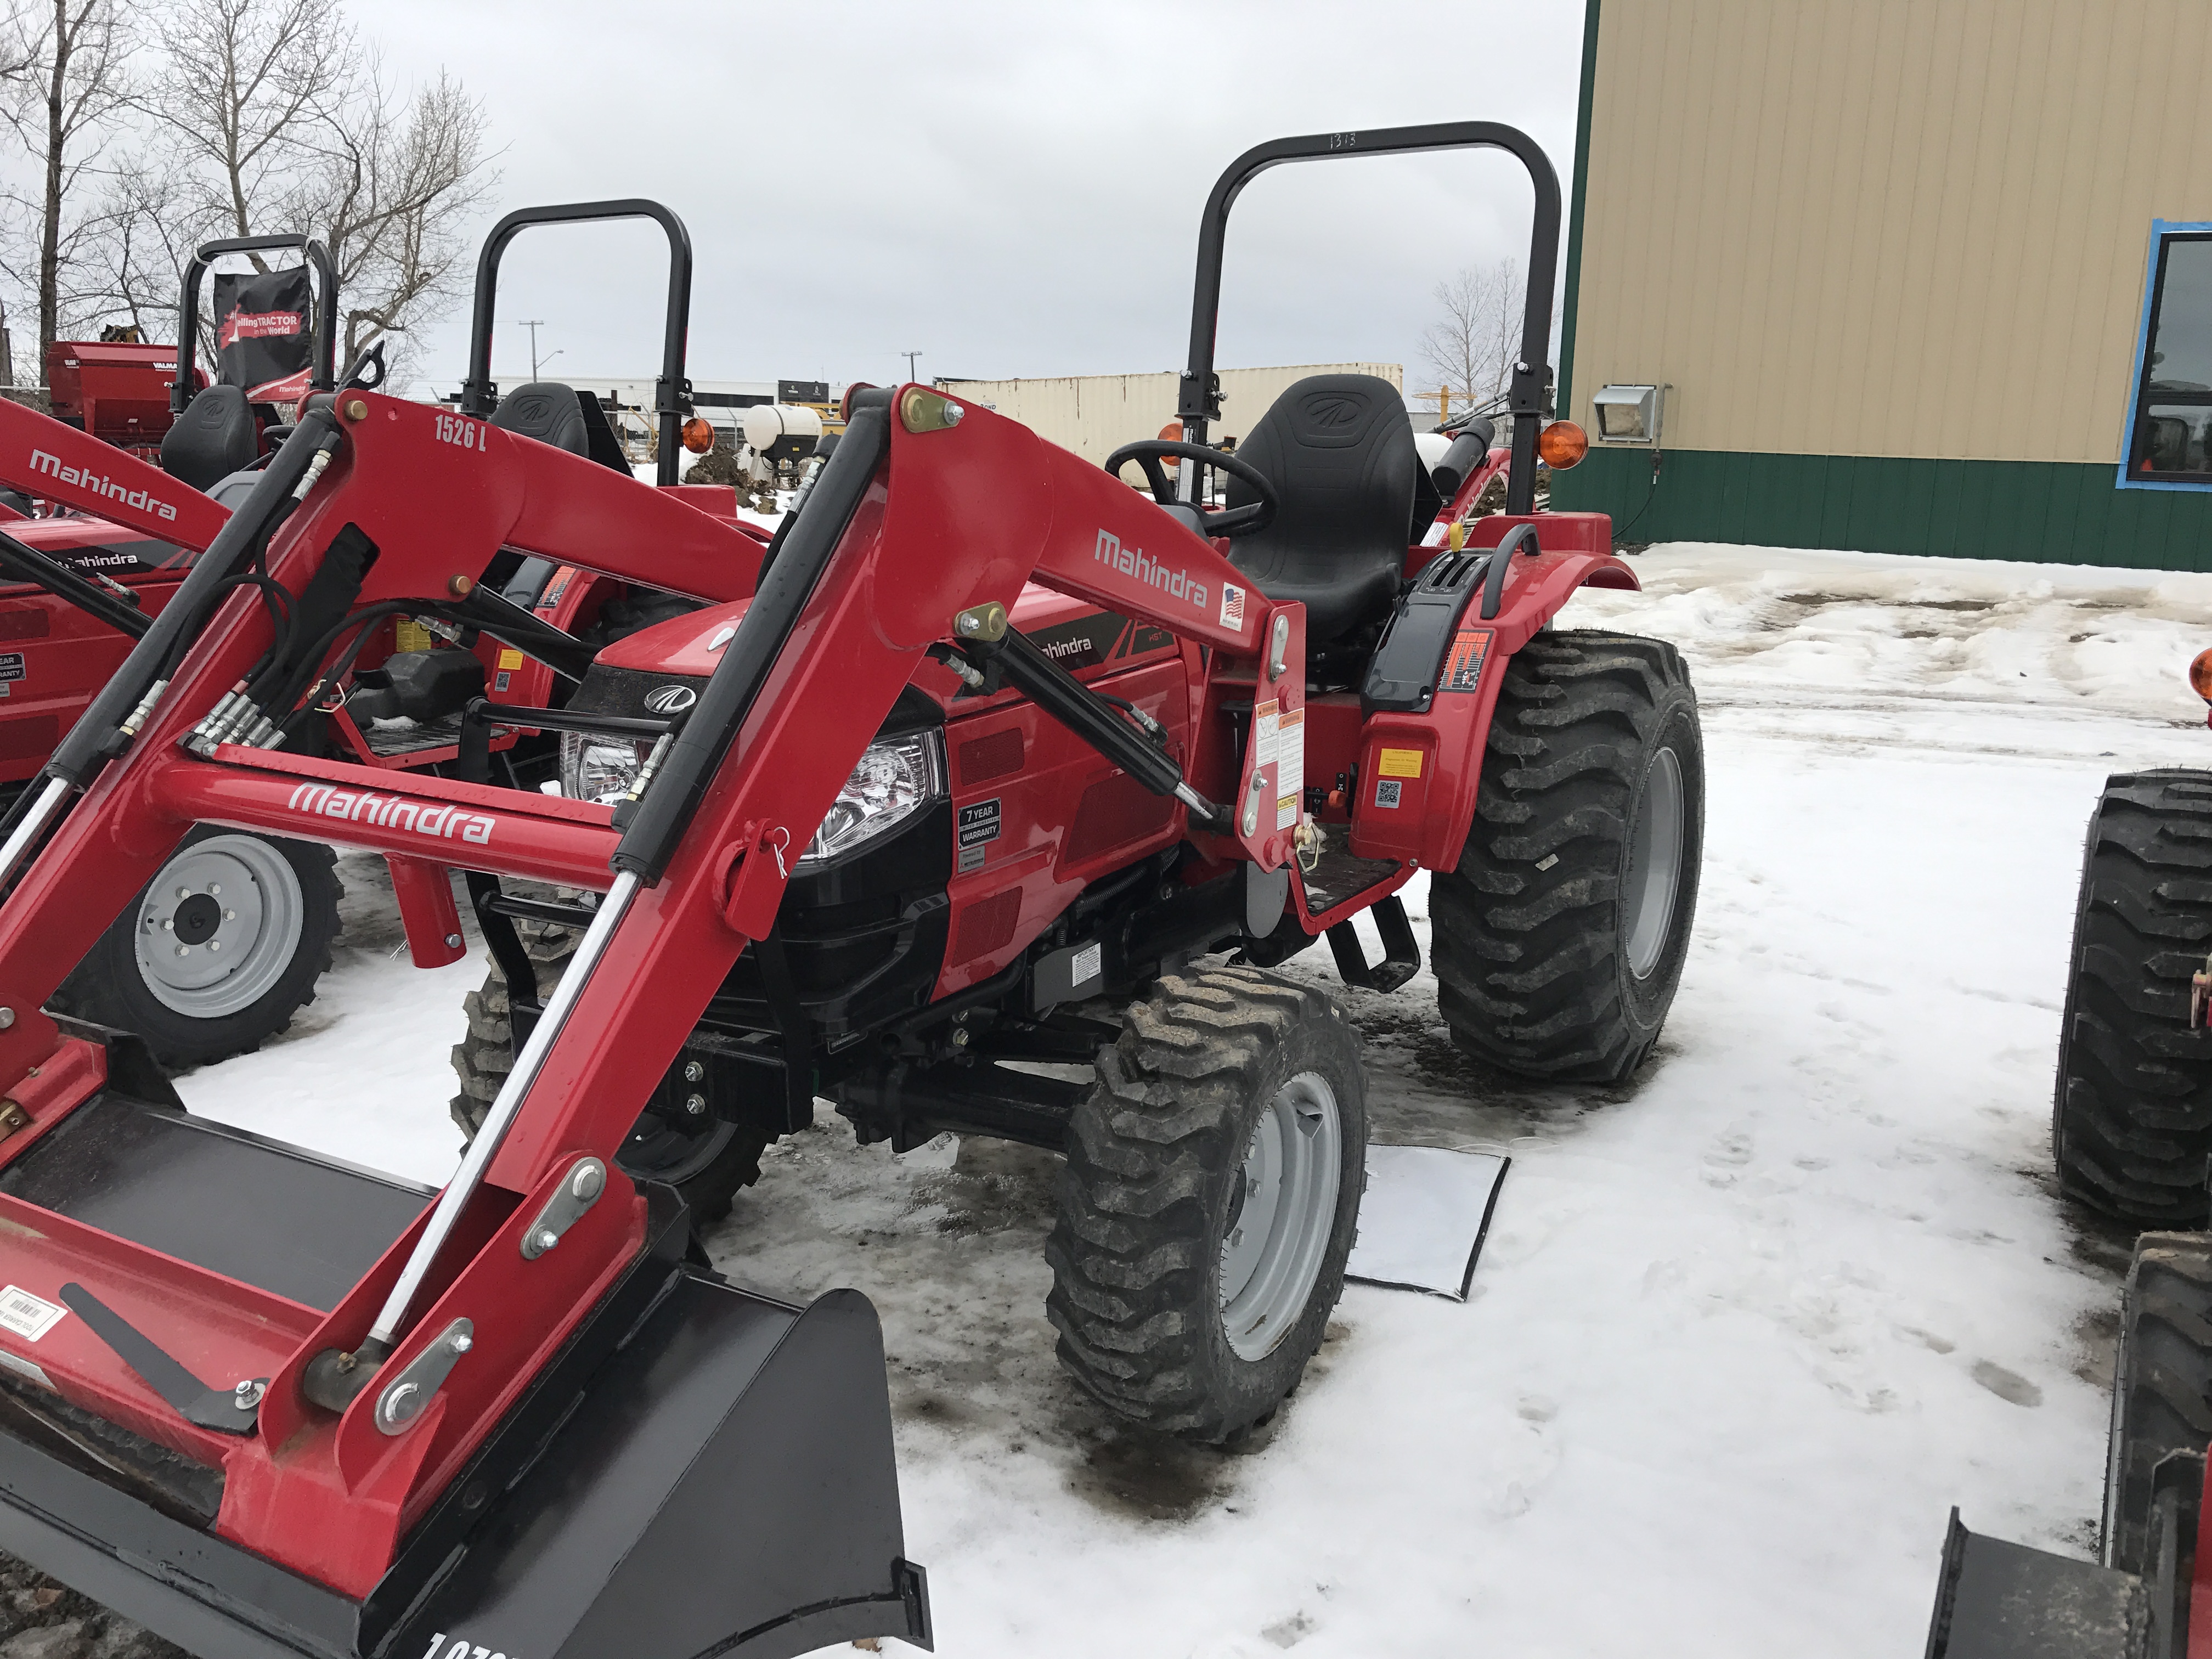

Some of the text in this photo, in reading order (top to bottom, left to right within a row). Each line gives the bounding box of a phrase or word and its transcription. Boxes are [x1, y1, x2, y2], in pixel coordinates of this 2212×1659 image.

[237, 318, 258, 328] elling
[257, 315, 297, 326] TRACTOR
[267, 326, 290, 335] World
[436, 414, 486, 452] 1526 L
[29, 449, 177, 522] Mahindra
[1094, 528, 1207, 608] Mahindra
[1148, 631, 1163, 642] HST
[1041, 637, 1092, 659] ahindra
[288, 781, 495, 845] Mahindra
[967, 806, 993, 822] 7 YEAR
[962, 825, 997, 842] WARRANTY
[22, 1322, 33, 1331] TOOL
